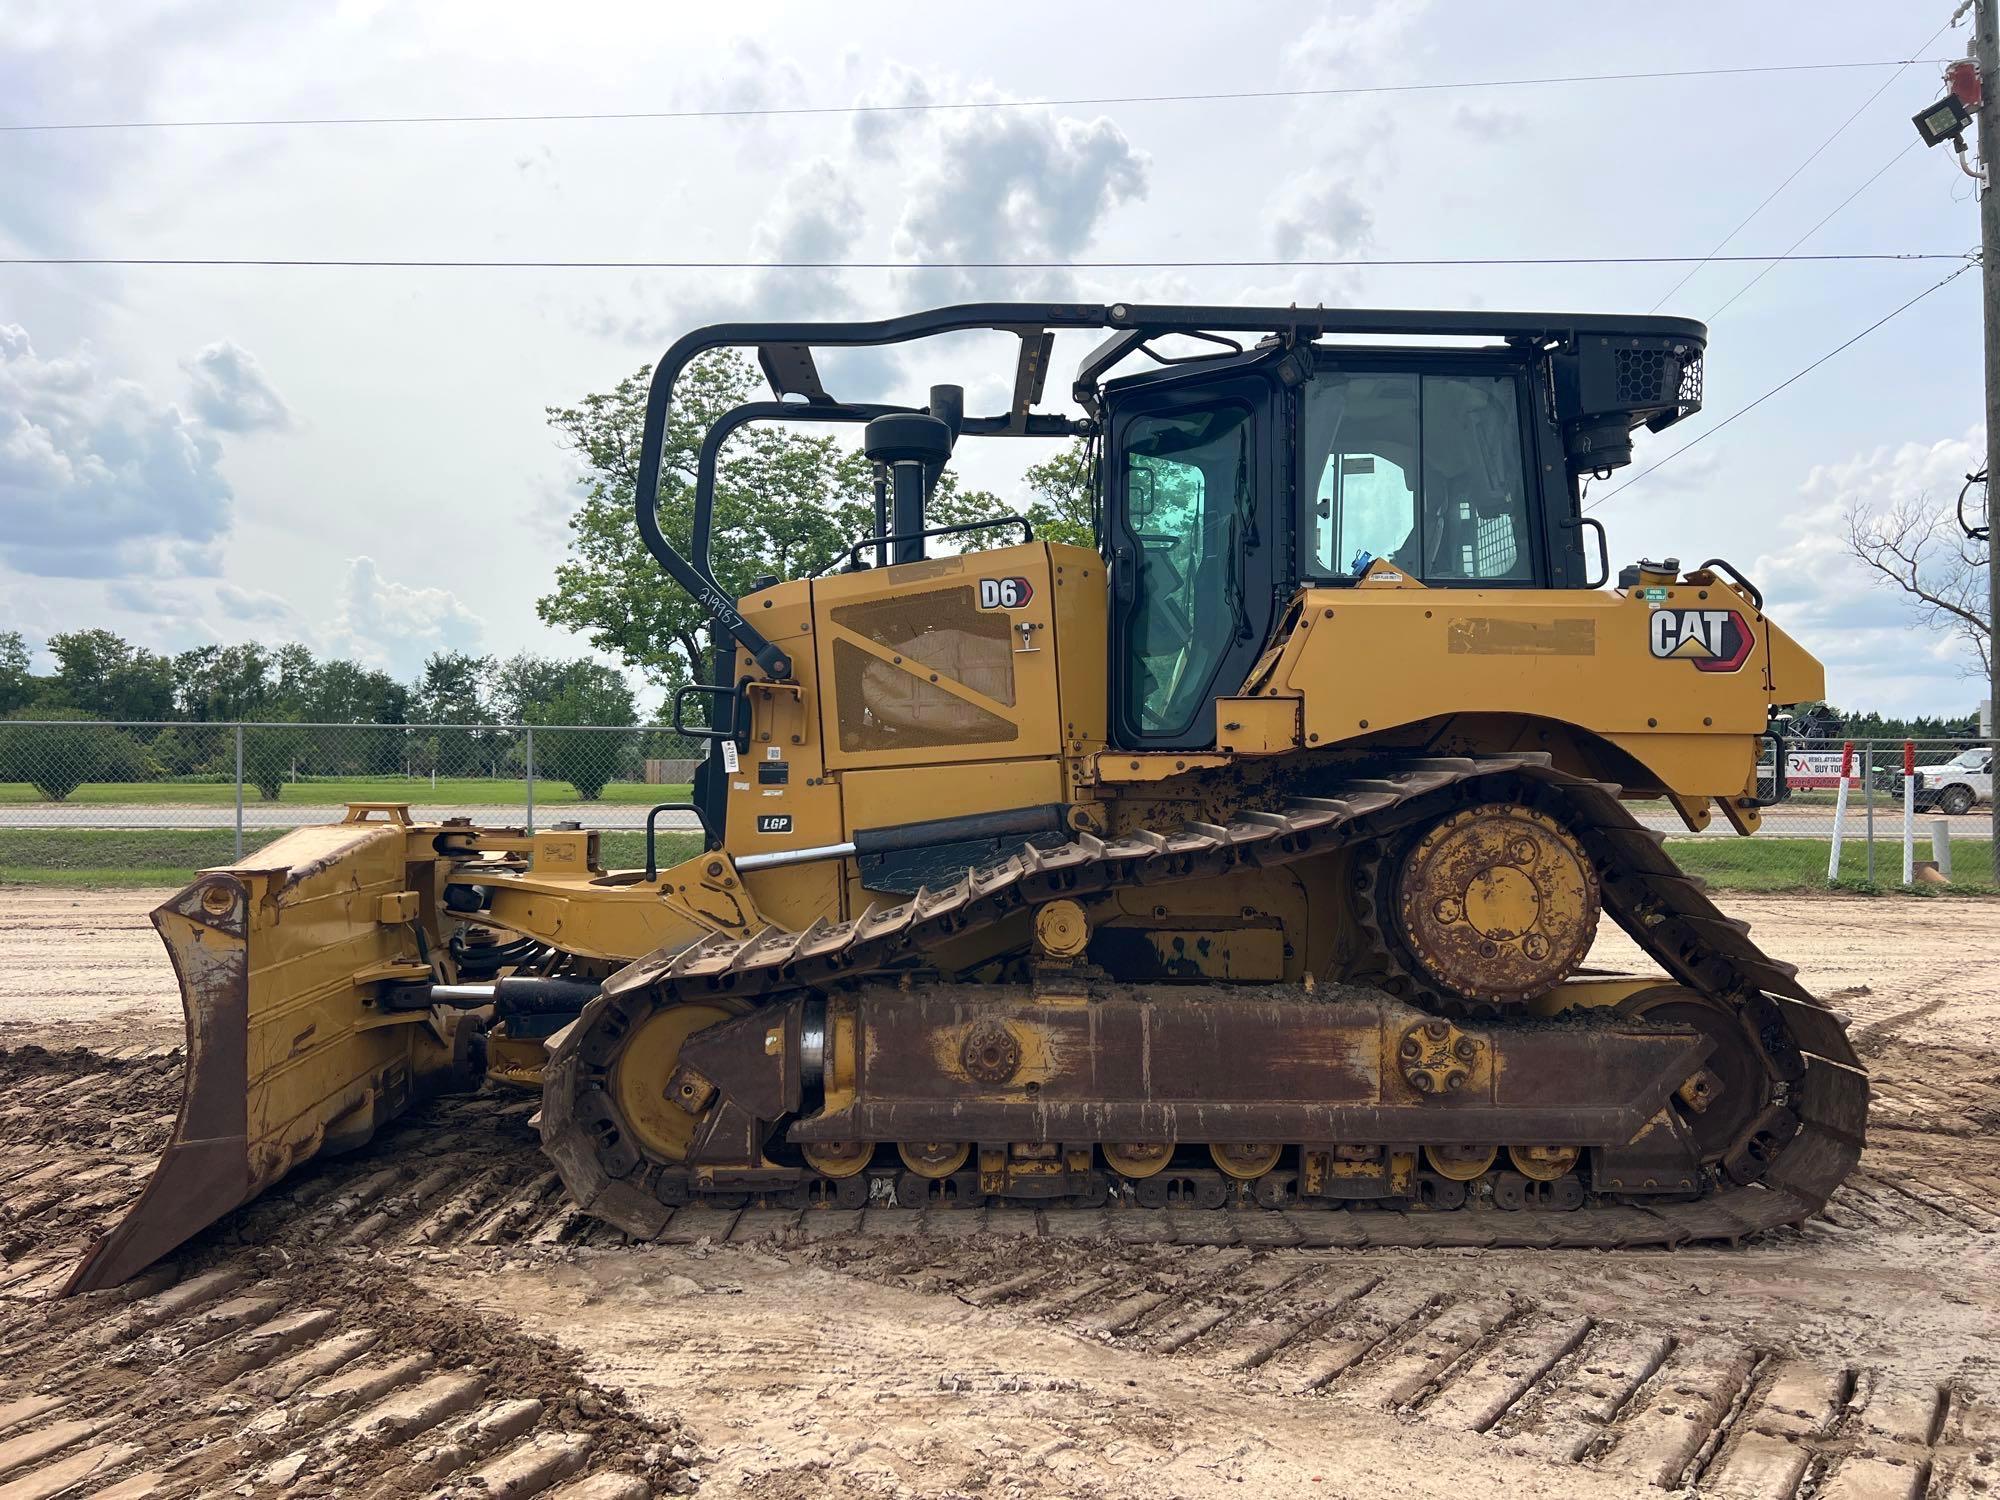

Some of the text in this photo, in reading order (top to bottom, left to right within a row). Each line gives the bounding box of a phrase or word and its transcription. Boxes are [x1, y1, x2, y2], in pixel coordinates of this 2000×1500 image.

[981, 579, 1017, 607] D6
[699, 587, 743, 630] 219987
[1651, 610, 1729, 657] CAT
[1814, 764, 1829, 773] BUY
[763, 818, 788, 830] LGP
